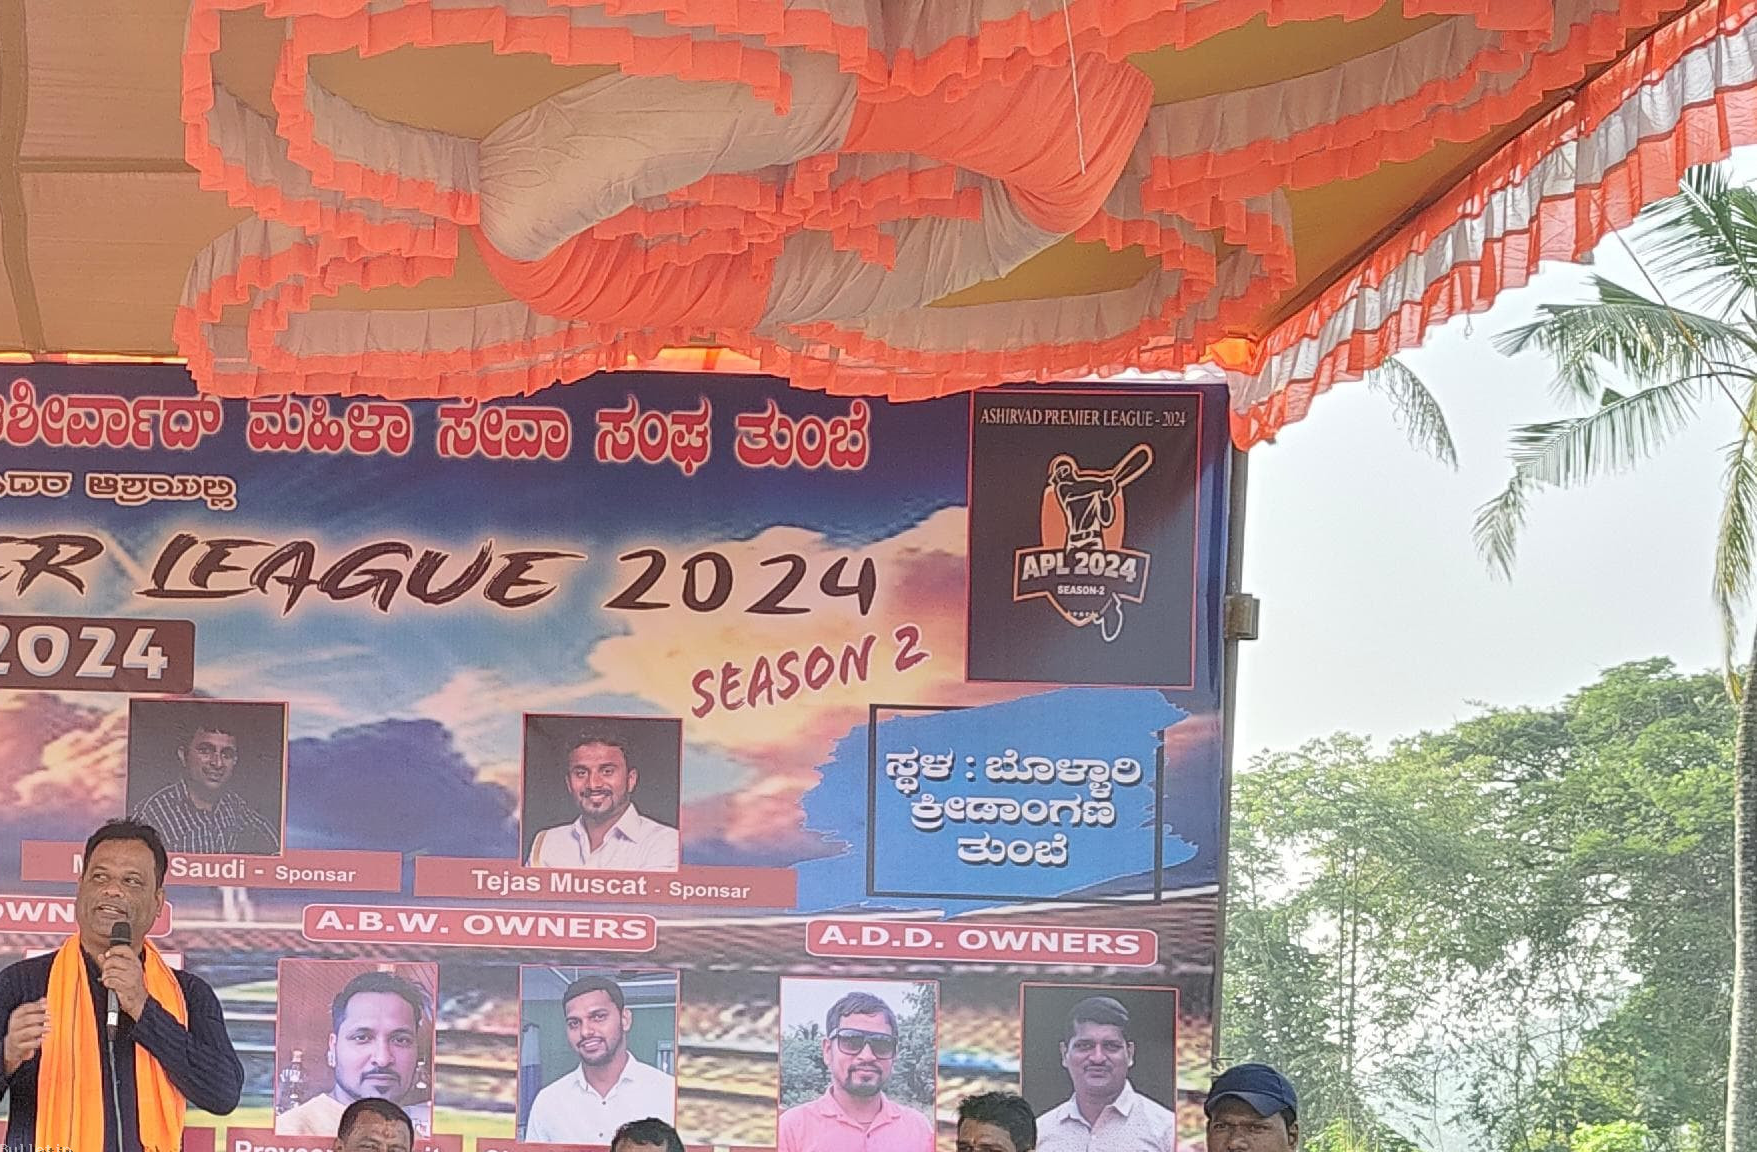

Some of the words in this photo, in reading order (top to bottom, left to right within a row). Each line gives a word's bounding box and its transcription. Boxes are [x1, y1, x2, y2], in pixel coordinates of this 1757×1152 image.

[980, 407, 1042, 425] ASHIRVAD
[1042, 410, 1100, 427] PREMIER
[1103, 411, 1154, 427] LEAGUE
[1162, 411, 1187, 427] 2024
[248, 396, 412, 455] ಮಹಿಳಾ
[440, 399, 570, 459] ಸೇವಾ
[597, 400, 710, 473] ಸಂಘ
[737, 401, 869, 468] ತುಂಬೆ
[135, 534, 587, 615] LEAGUE
[603, 547, 877, 616] 2024
[1021, 553, 1071, 581] APL
[1074, 552, 1137, 583] 2024
[1057, 585, 1105, 596] SEASON-2
[691, 634, 876, 719] SEASON
[894, 626, 930, 671] 2
[885, 747, 955, 797] ಸ್ಥಳ
[911, 794, 1116, 830] ಕ್ರೀಡಾಂಗಣ
[957, 831, 1068, 865] ತುಂಬೆ
[170, 857, 245, 879] Saudi
[276, 865, 356, 884] Sponsar
[471, 870, 540, 896] Tejas
[550, 872, 647, 896] Muscat
[669, 881, 750, 900] Sponsar
[316, 910, 448, 934] A.B.W.
[463, 915, 647, 940] OWNERS
[819, 925, 944, 948] A.D.D.
[957, 930, 1140, 955] OWNERS
